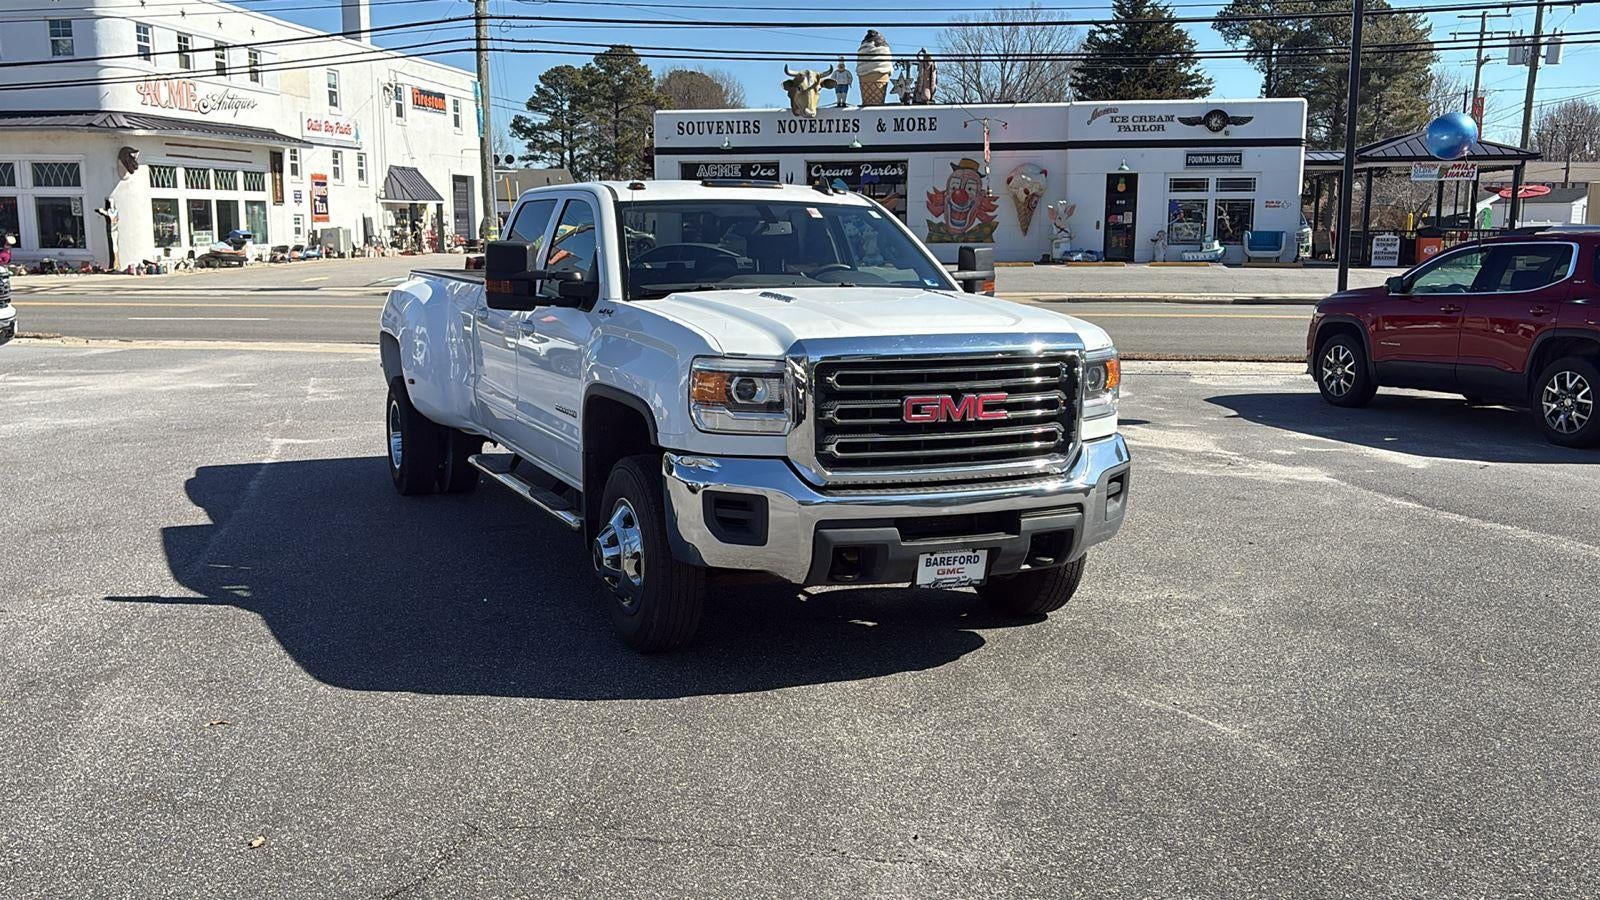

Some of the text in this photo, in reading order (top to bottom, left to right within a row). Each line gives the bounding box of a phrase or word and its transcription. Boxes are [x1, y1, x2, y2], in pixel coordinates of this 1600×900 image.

[136, 76, 198, 112] ACME
[213, 88, 258, 118] Antiques
[677, 116, 938, 136] SOUVENIRS NOVELTIES & MORE
[1110, 114, 1175, 124] ICE CREAM
[324, 120, 334, 136] Boy
[1117, 124, 1166, 132] PARLOR
[1187, 154, 1241, 164] FOUNTAIN SERVICE
[696, 163, 777, 177] ACME Ice
[810, 163, 905, 177] Cream Parlor
[1451, 163, 1477, 171] MILK
[315, 201, 327, 213] TEA
[903, 392, 1009, 423] GMC
[925, 554, 980, 568] BAREFORD
[936, 567, 966, 576] GMC
